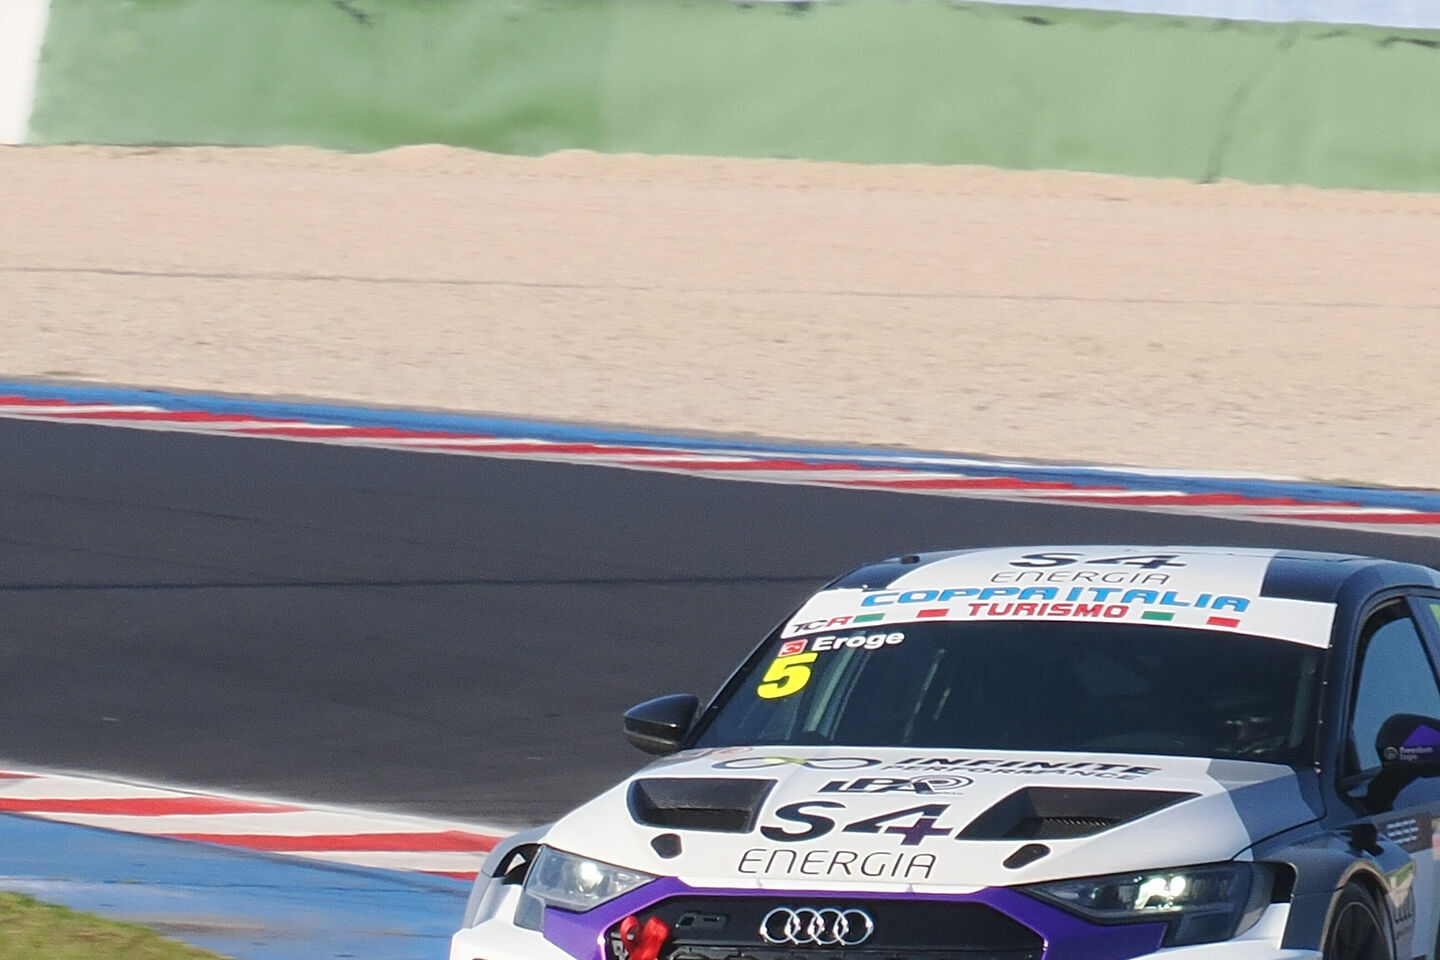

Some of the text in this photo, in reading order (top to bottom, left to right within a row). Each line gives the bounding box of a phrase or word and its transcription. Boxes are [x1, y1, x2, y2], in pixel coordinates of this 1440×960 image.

[989, 570, 1171, 586] ENERGIA
[860, 585, 1252, 613] COPPA ITALIA
[967, 601, 1130, 619] TURISMO
[791, 615, 854, 634] TCR
[810, 631, 906, 652] Eroge
[756, 651, 819, 700] 5
[879, 764, 1143, 782] PERFORMANCE
[894, 756, 1163, 776] INFINITE
[759, 800, 955, 846] S4
[737, 848, 937, 879] ENERGIA
